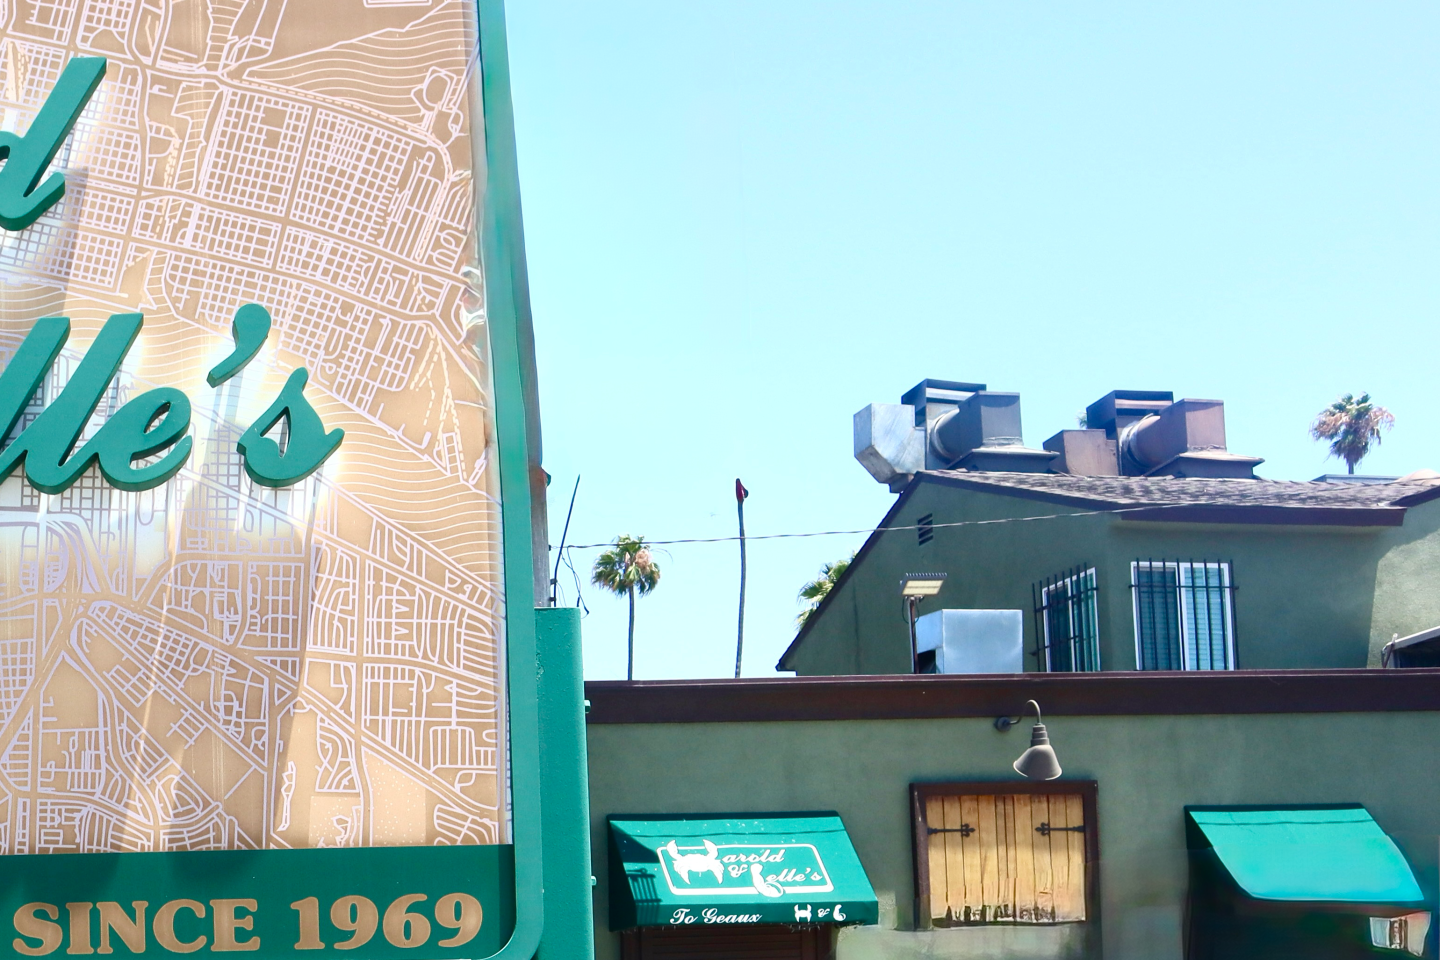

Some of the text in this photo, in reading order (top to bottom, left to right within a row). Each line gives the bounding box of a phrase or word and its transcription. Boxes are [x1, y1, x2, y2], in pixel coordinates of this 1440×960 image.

[12, 898, 261, 956] SINCE
[290, 892, 484, 951] 1969
[669, 908, 698, 924] To
[701, 907, 763, 924] Geaux
